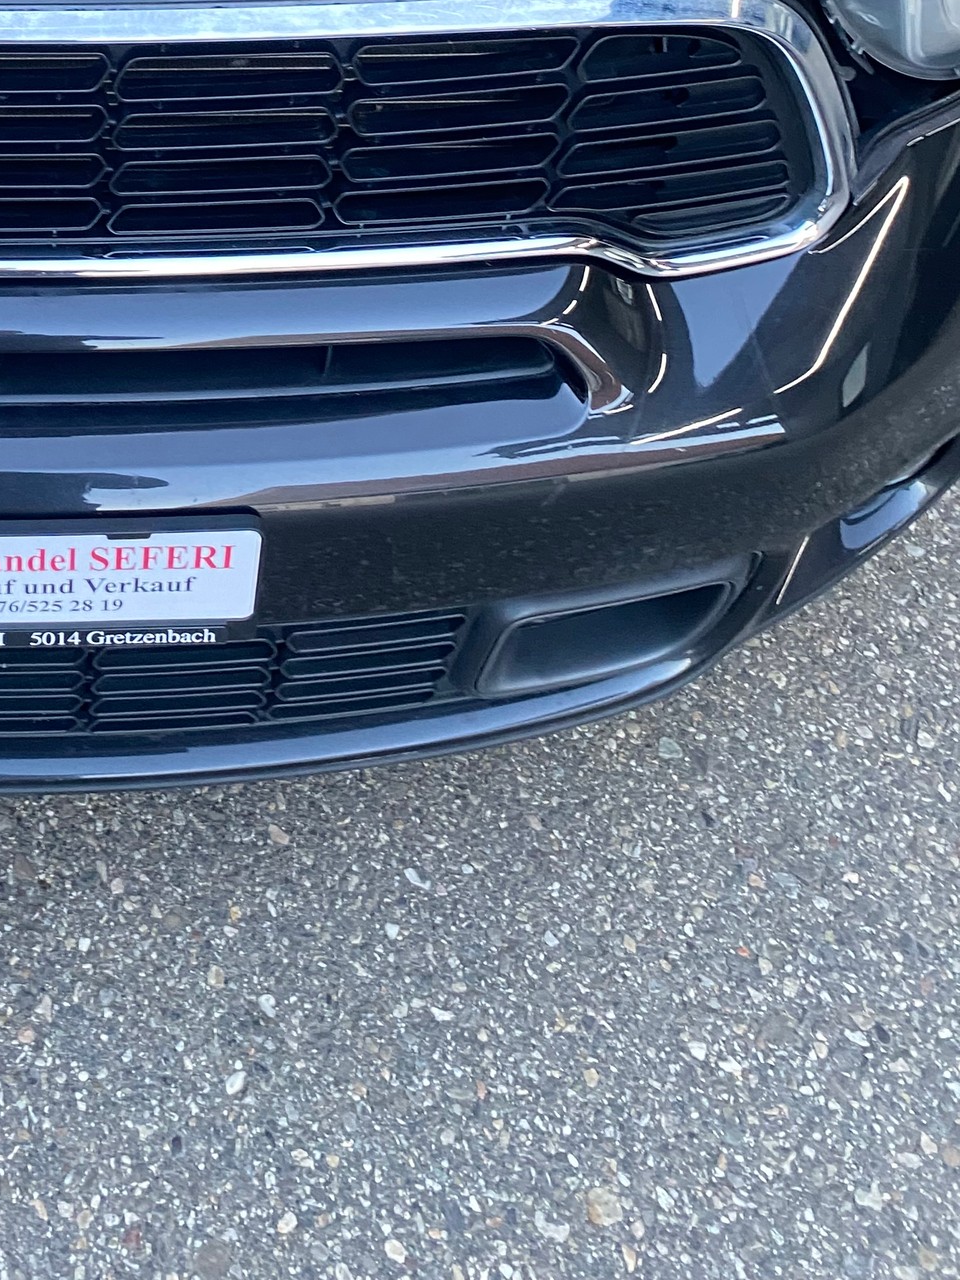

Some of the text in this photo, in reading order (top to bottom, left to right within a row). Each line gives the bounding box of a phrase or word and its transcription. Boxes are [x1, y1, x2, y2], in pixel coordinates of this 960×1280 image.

[89, 545, 235, 571] SEFERI
[24, 578, 74, 594] und
[84, 576, 197, 593] Verkauf
[69, 600, 93, 612] 28
[100, 598, 123, 612] 19
[29, 631, 81, 646] 5014
[86, 628, 216, 645] Gretzenbach
